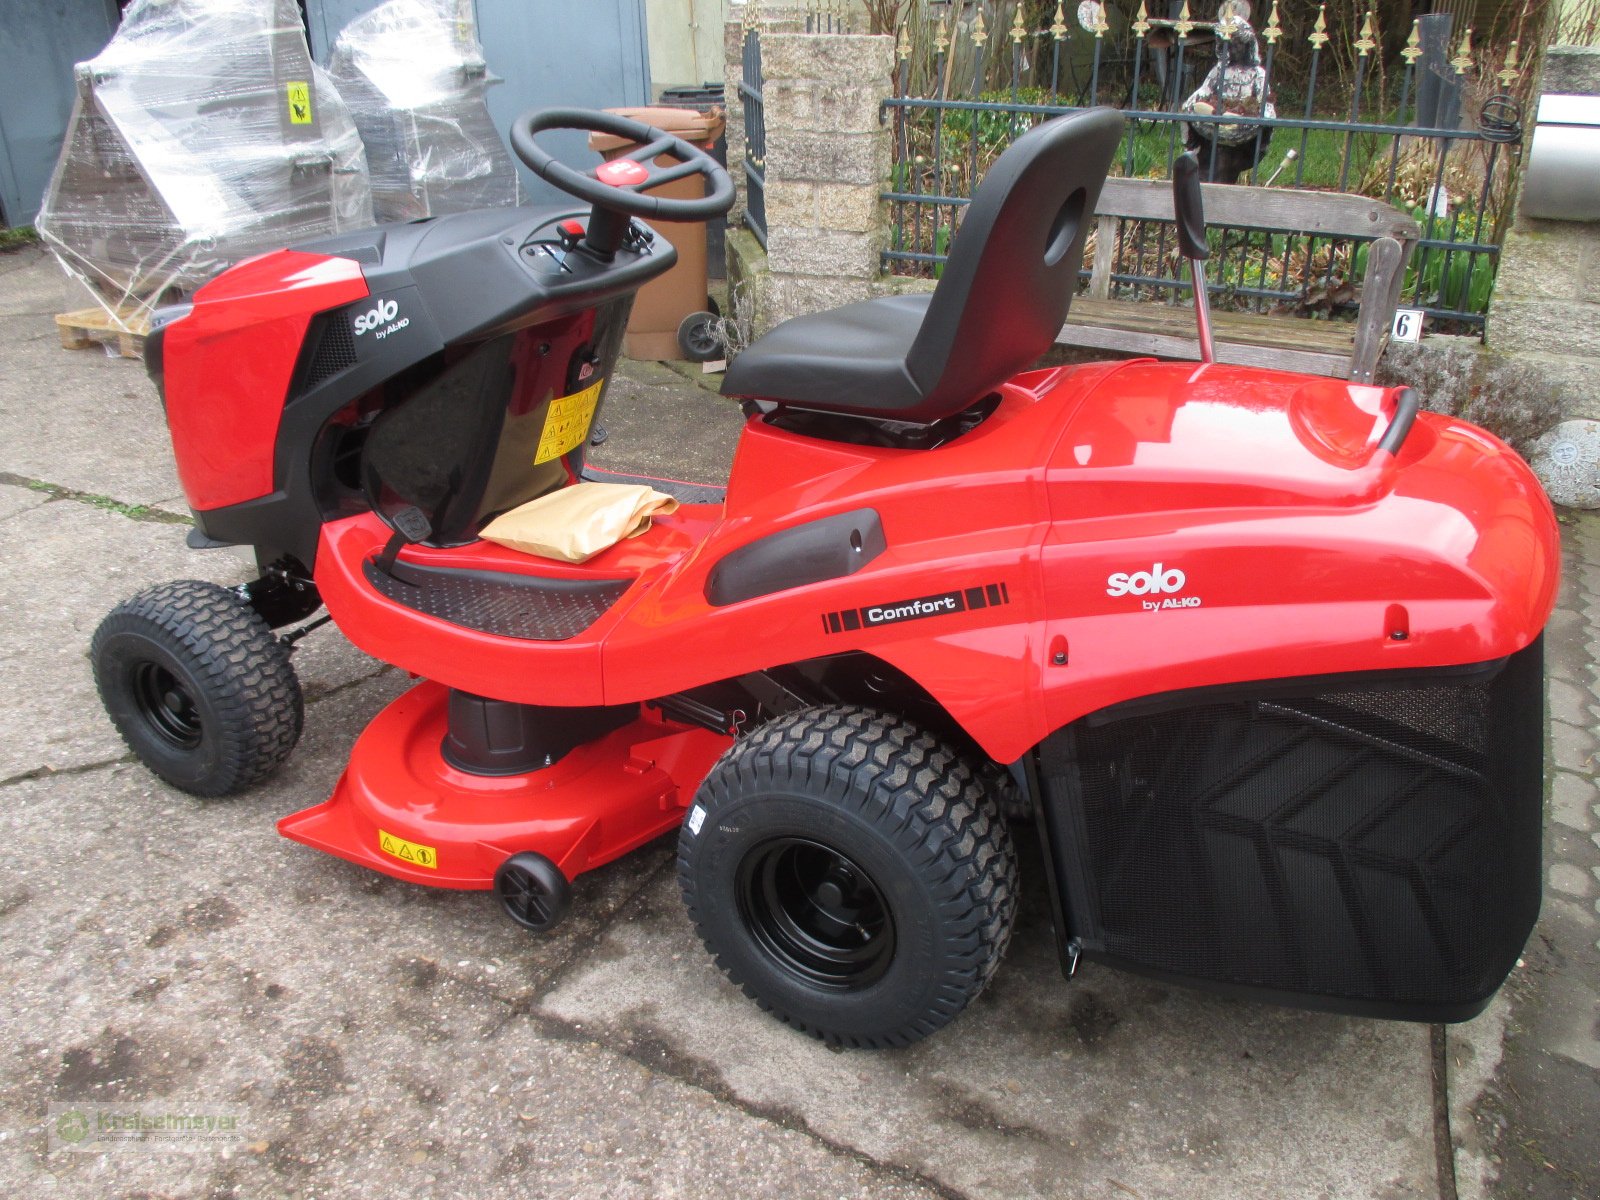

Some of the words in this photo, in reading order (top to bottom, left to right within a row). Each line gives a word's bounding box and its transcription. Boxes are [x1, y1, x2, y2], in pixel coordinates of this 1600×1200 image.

[354, 299, 398, 336] solo
[376, 329, 387, 339] by
[387, 318, 410, 334] AL-KO
[1396, 314, 1410, 337] 6
[1106, 562, 1186, 597] solo
[868, 597, 956, 622] Comfort
[1142, 600, 1161, 612] by
[1162, 597, 1202, 609] AL-KO
